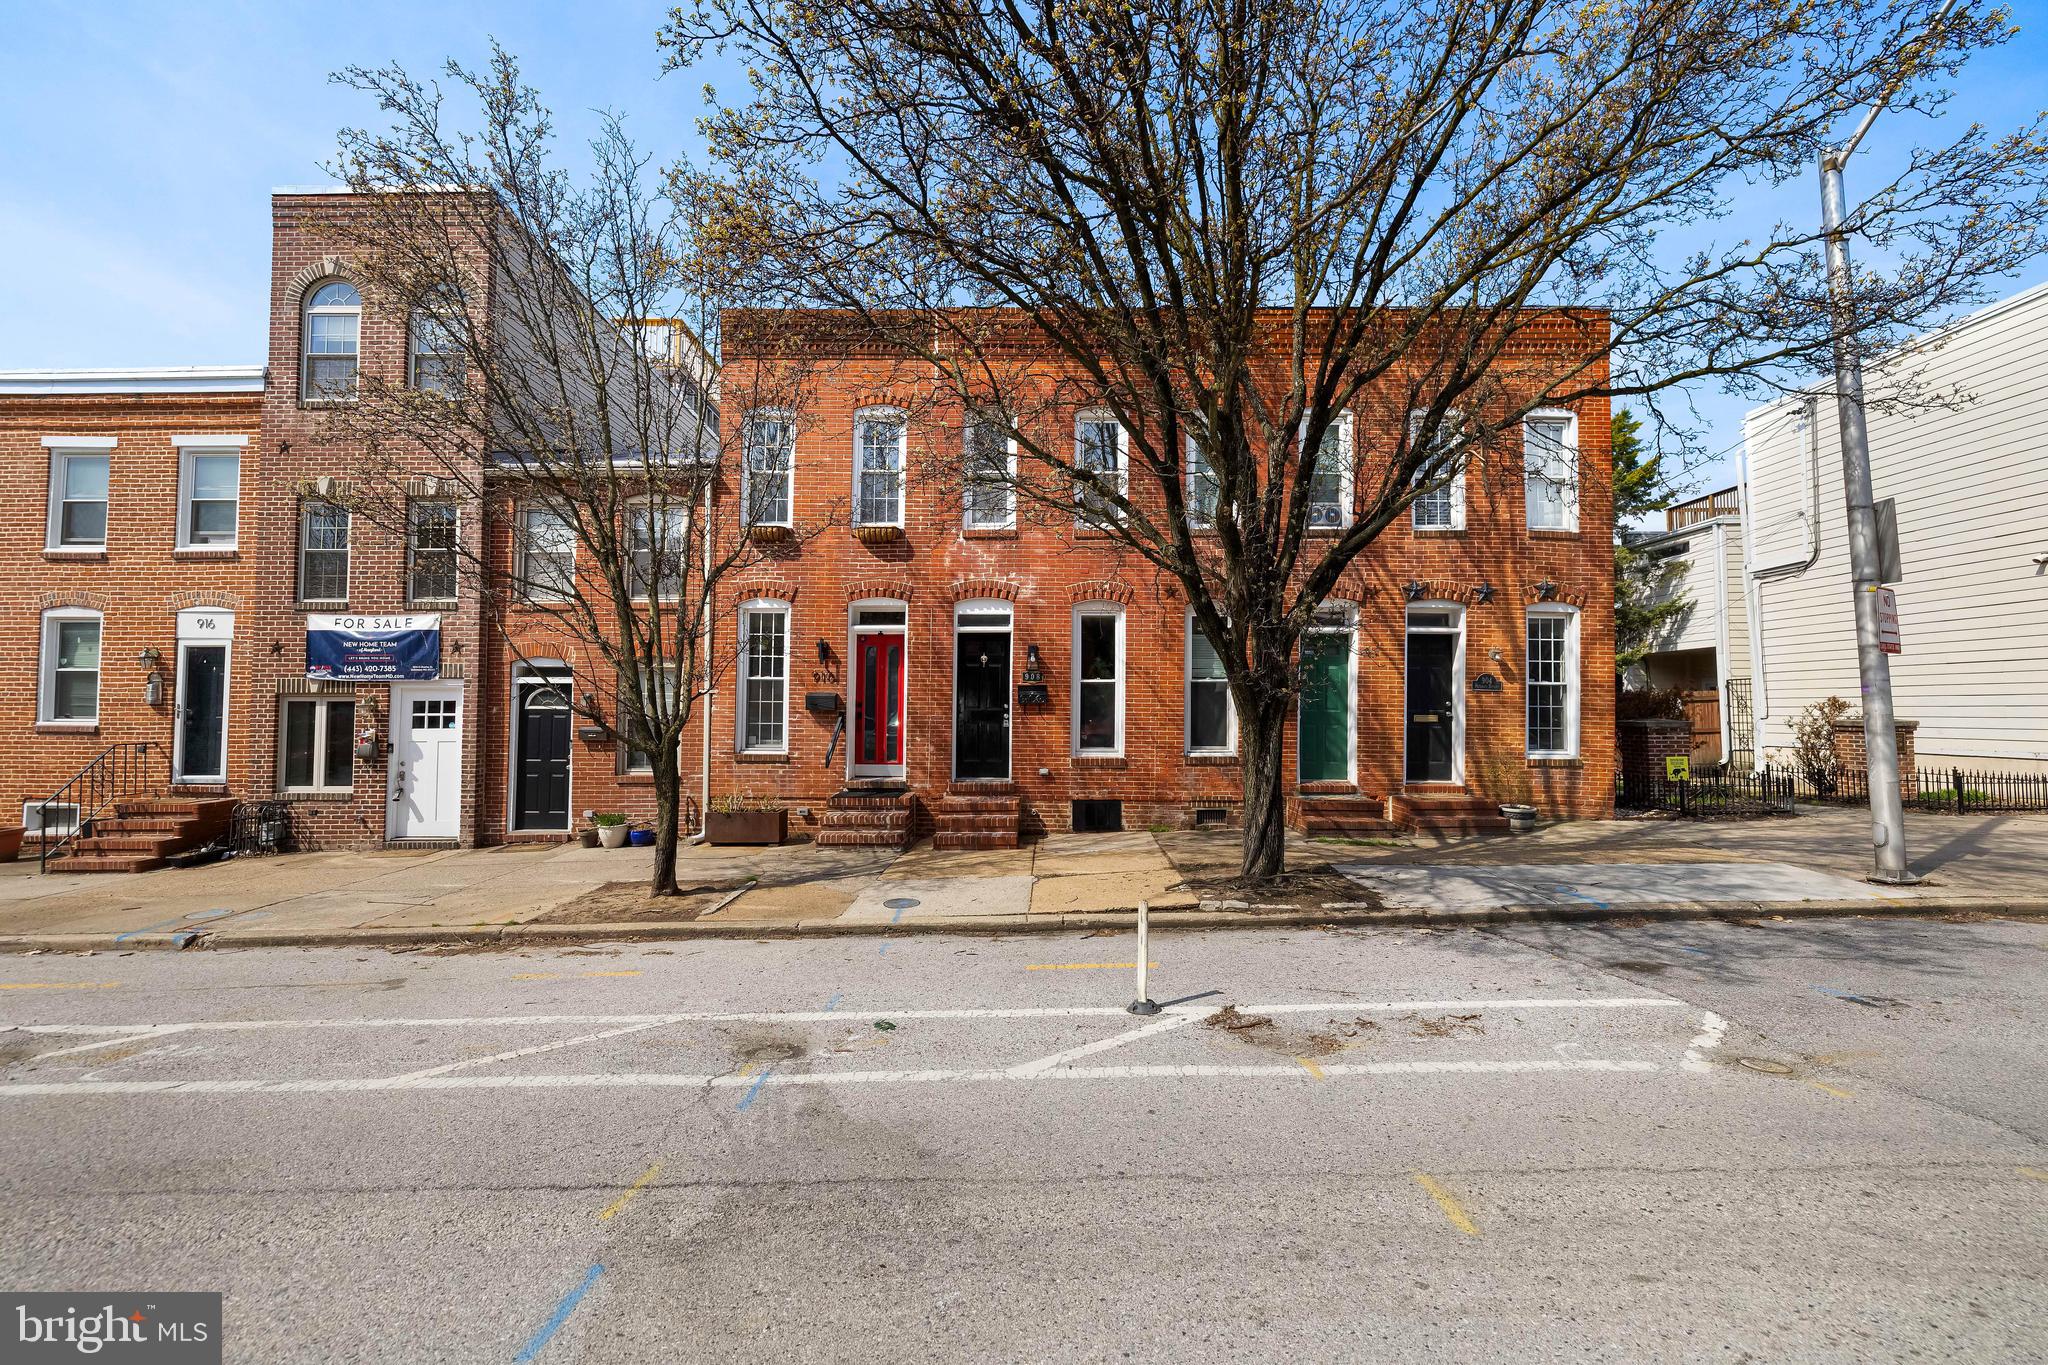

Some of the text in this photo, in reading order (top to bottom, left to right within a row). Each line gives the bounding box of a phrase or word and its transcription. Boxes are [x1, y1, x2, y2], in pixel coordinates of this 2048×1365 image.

[1883, 594, 1891, 607] NO
[196, 618, 216, 630] 916
[334, 617, 413, 629] FOR SALE
[343, 664, 363, 673] (443)
